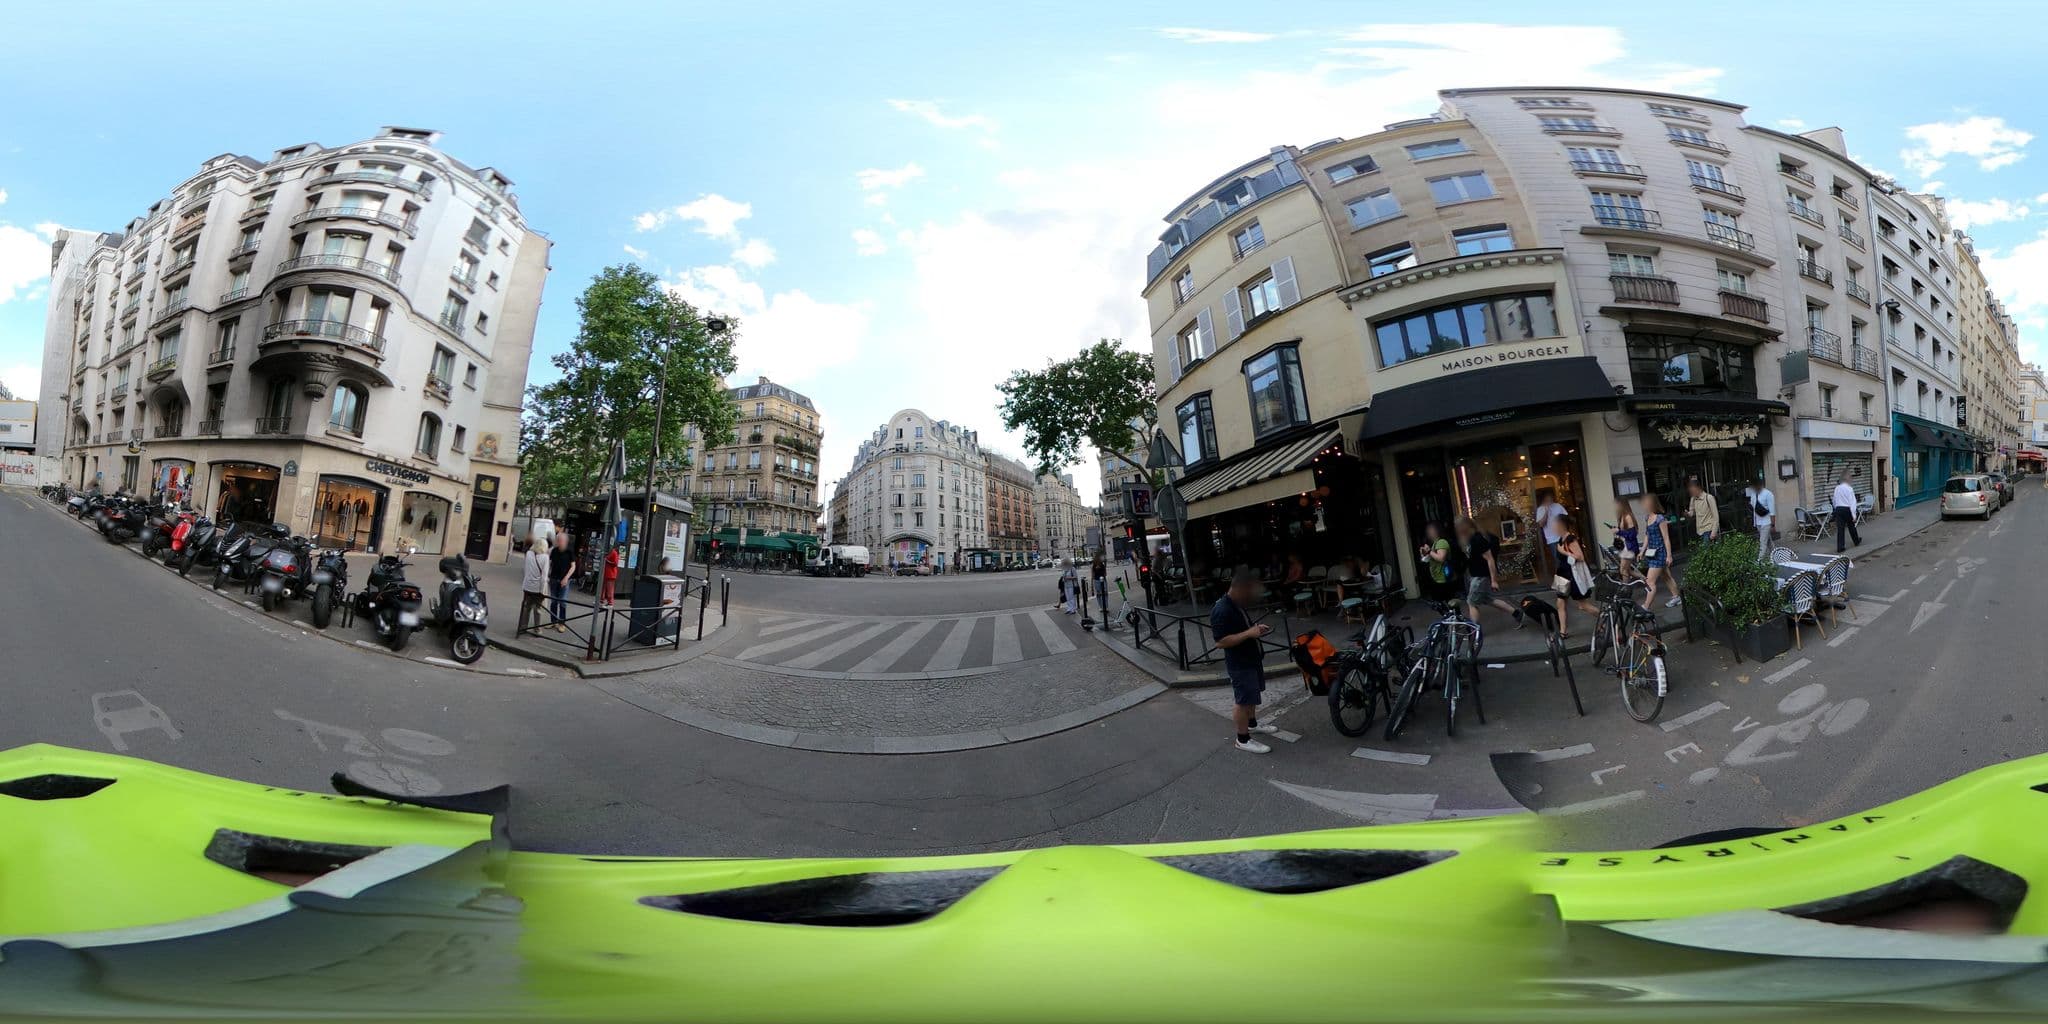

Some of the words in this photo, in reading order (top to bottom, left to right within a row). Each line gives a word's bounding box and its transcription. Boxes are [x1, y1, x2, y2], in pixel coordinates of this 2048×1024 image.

[1442, 354, 1493, 372] MAISON
[1498, 346, 1569, 362] BOURGEAT
[366, 459, 431, 485] CHEVIGNON
